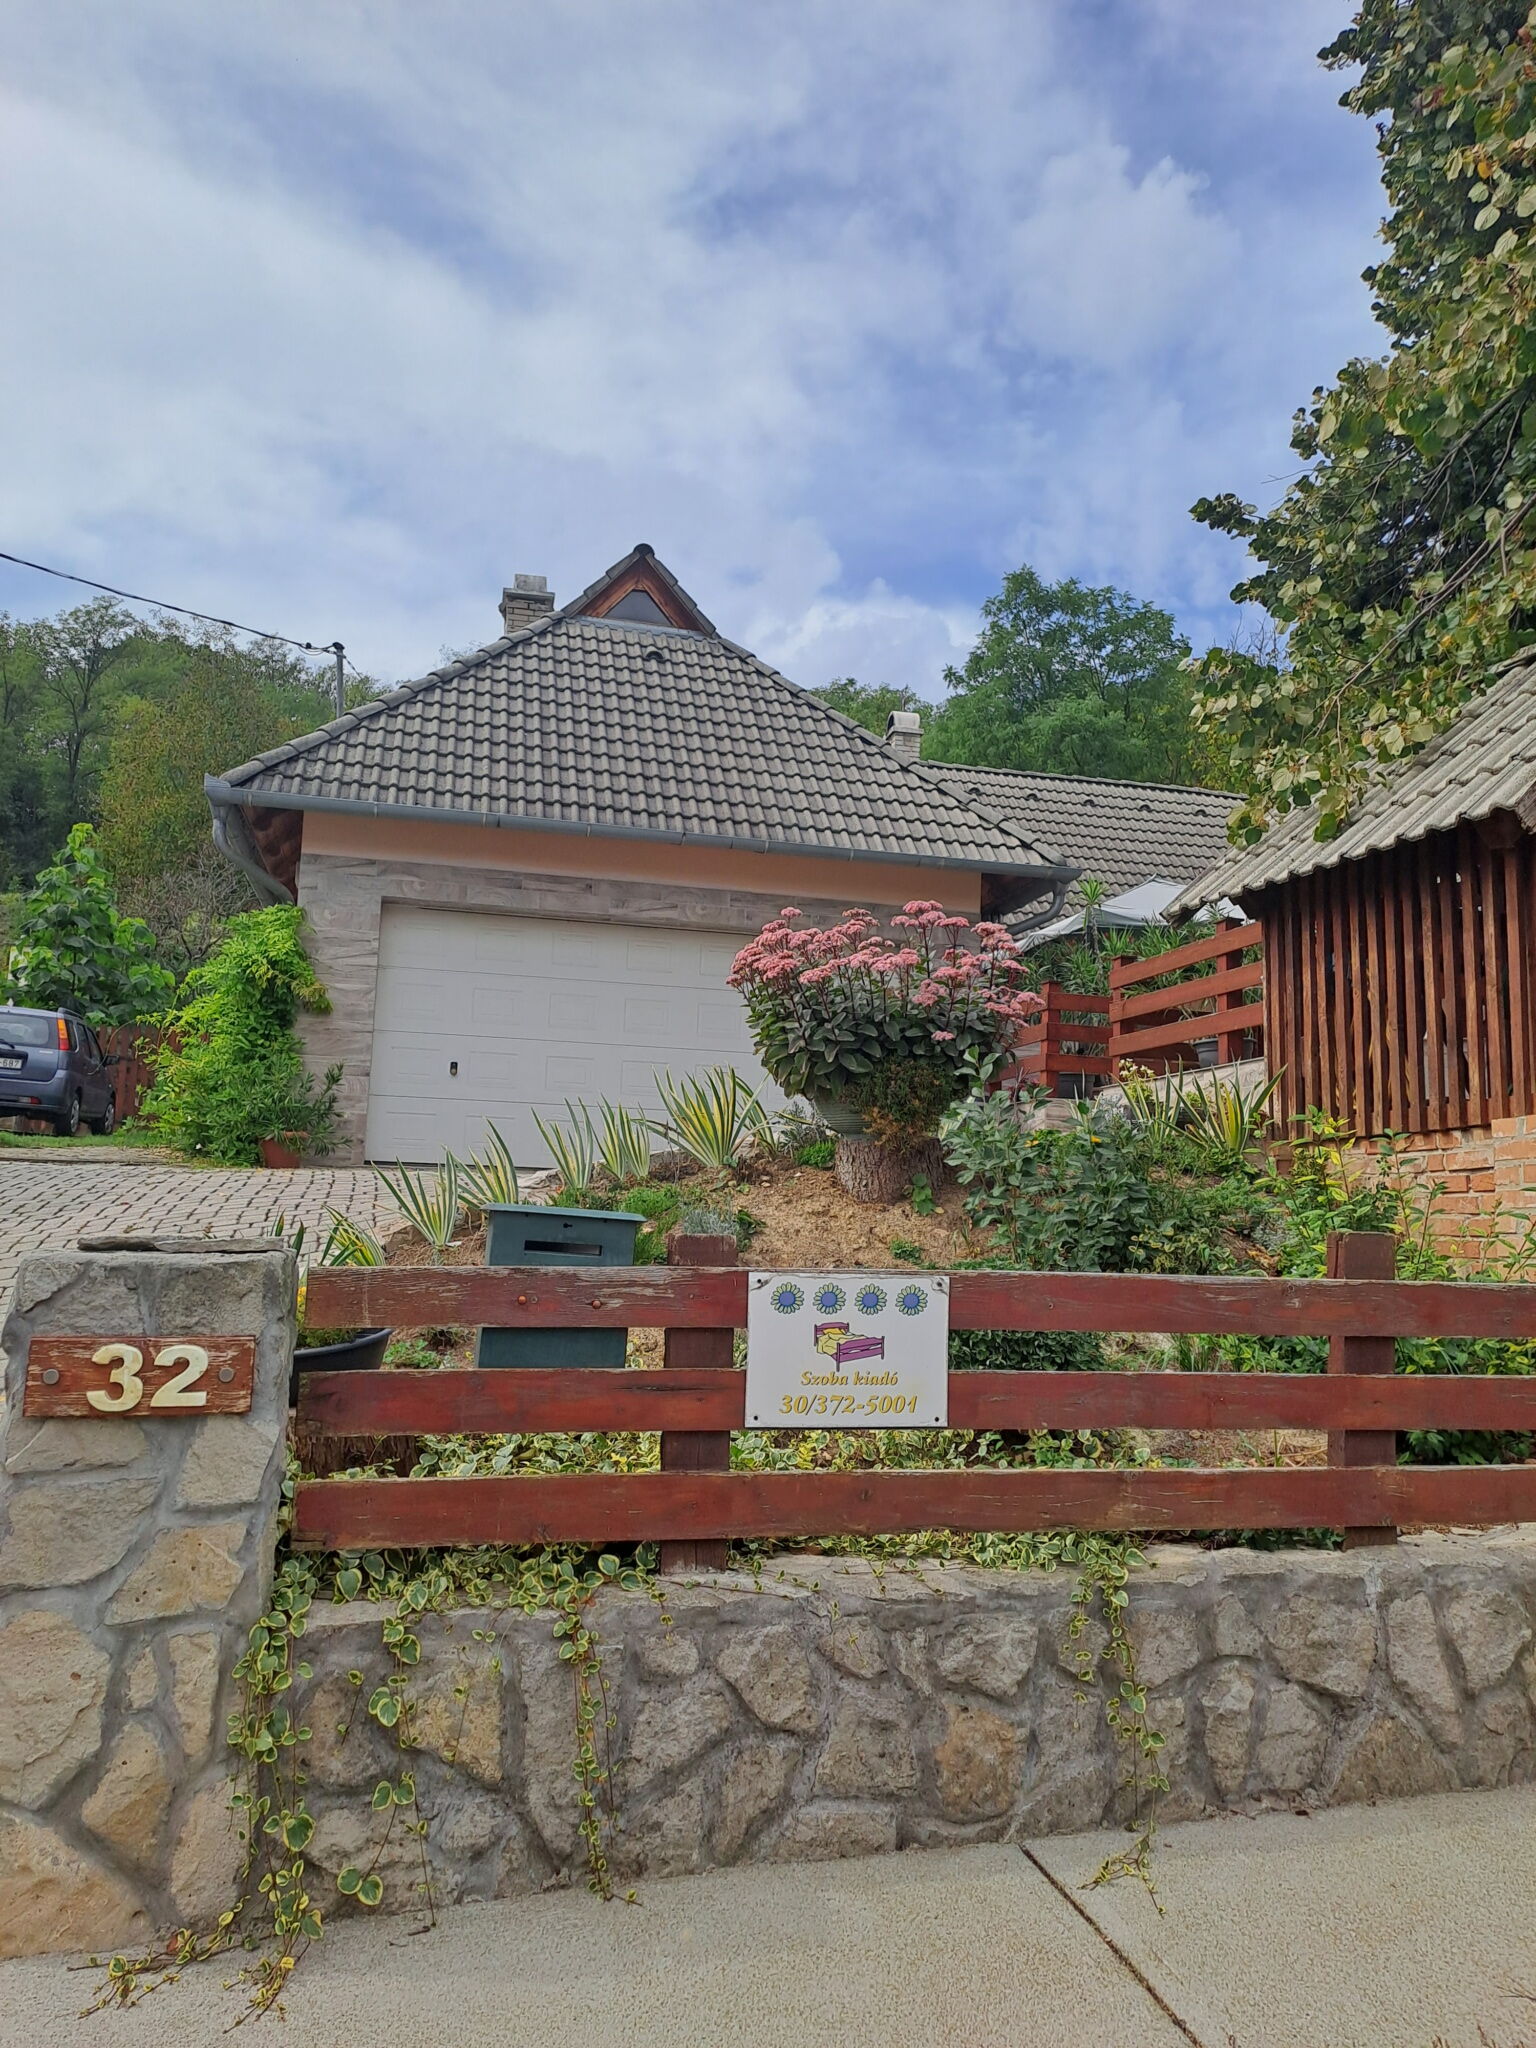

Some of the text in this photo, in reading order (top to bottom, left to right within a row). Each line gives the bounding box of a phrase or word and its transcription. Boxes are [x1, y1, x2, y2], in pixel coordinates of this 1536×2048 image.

[86, 1343, 209, 1411] 32
[801, 1370, 899, 1386] Szoba kiadó
[779, 1394, 918, 1416] 30/372-5001
